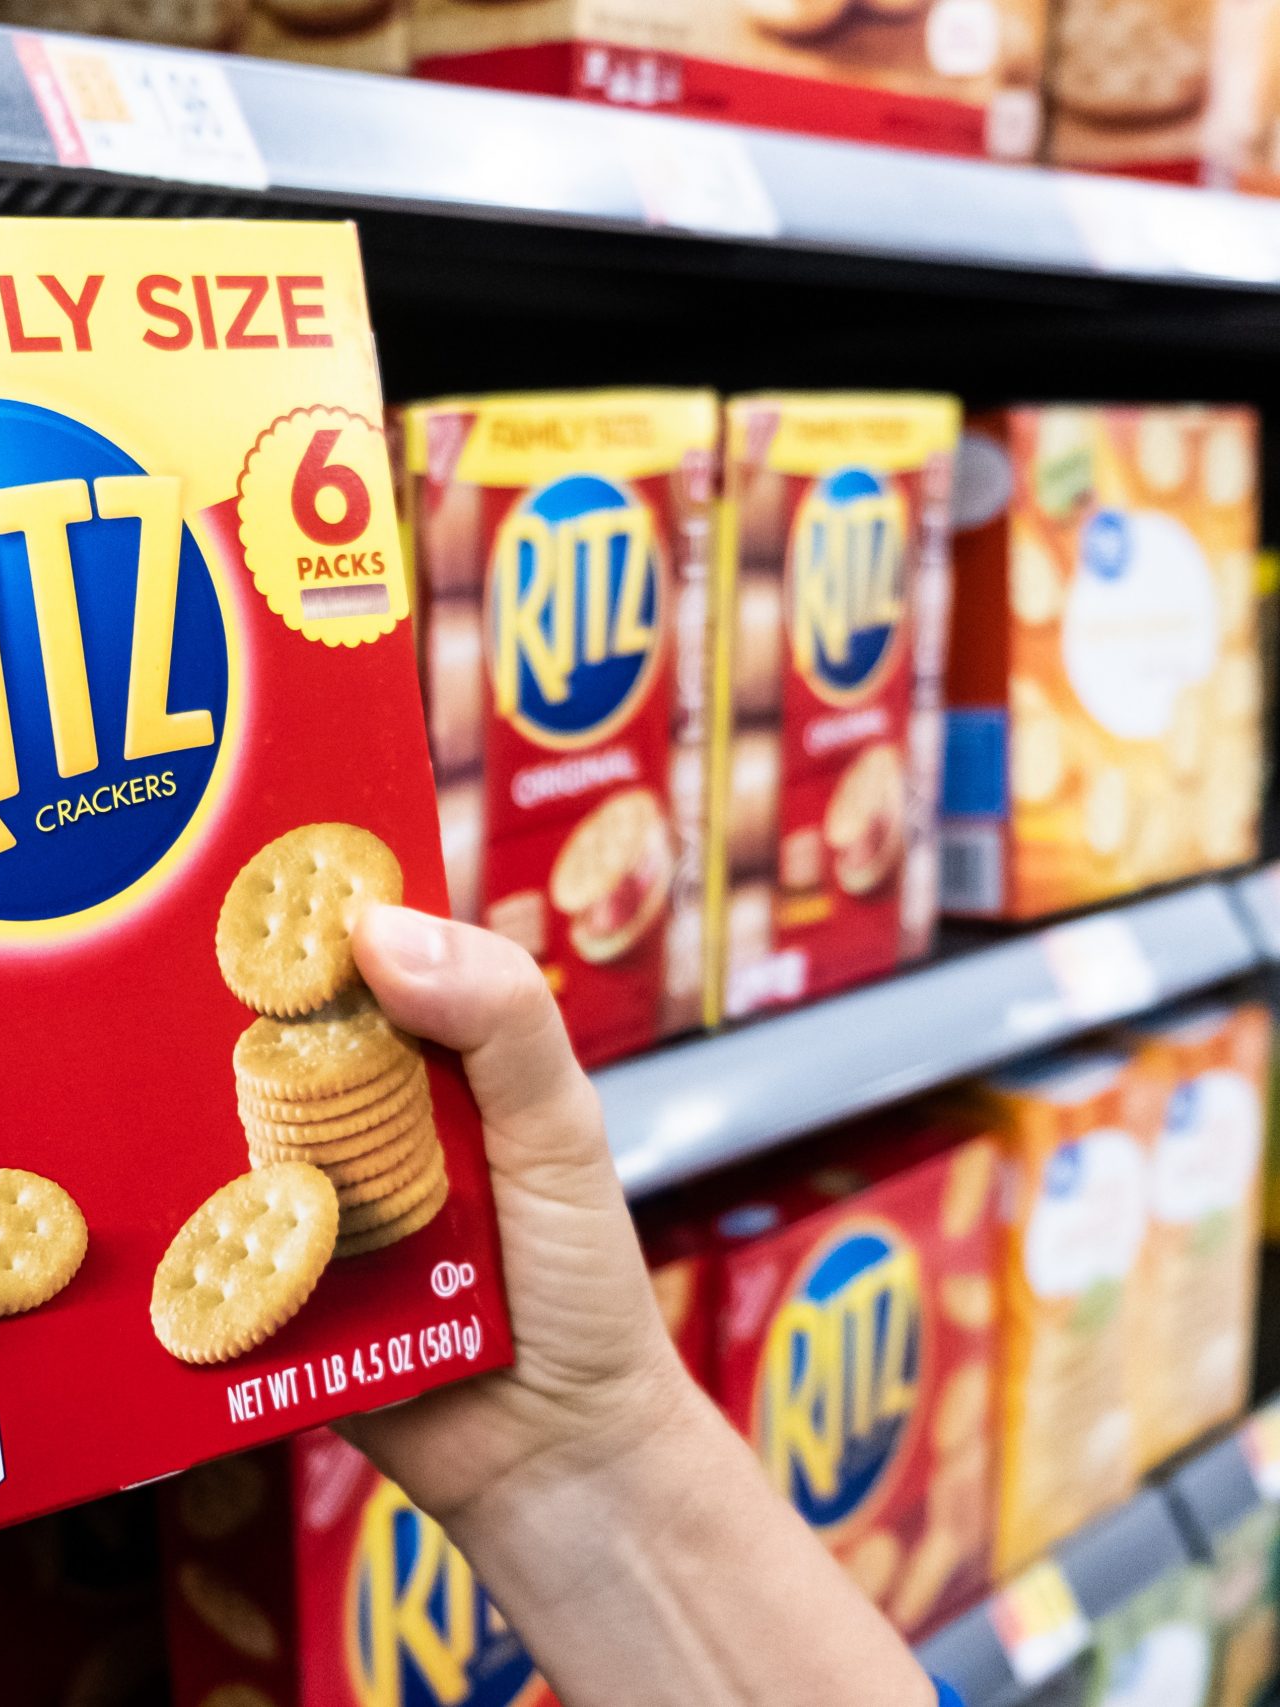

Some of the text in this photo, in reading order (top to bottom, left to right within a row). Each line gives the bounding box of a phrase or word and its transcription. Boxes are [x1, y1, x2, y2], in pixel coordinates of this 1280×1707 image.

[135, 274, 335, 352] SIZE
[291, 429, 371, 546] 6
[296, 551, 386, 582] PACKS
[494, 506, 654, 717] RITZ
[35, 771, 177, 832] CRACKERS
[226, 1314, 482, 1424] NET WT 1 LB 4.5 OZ (581g)
